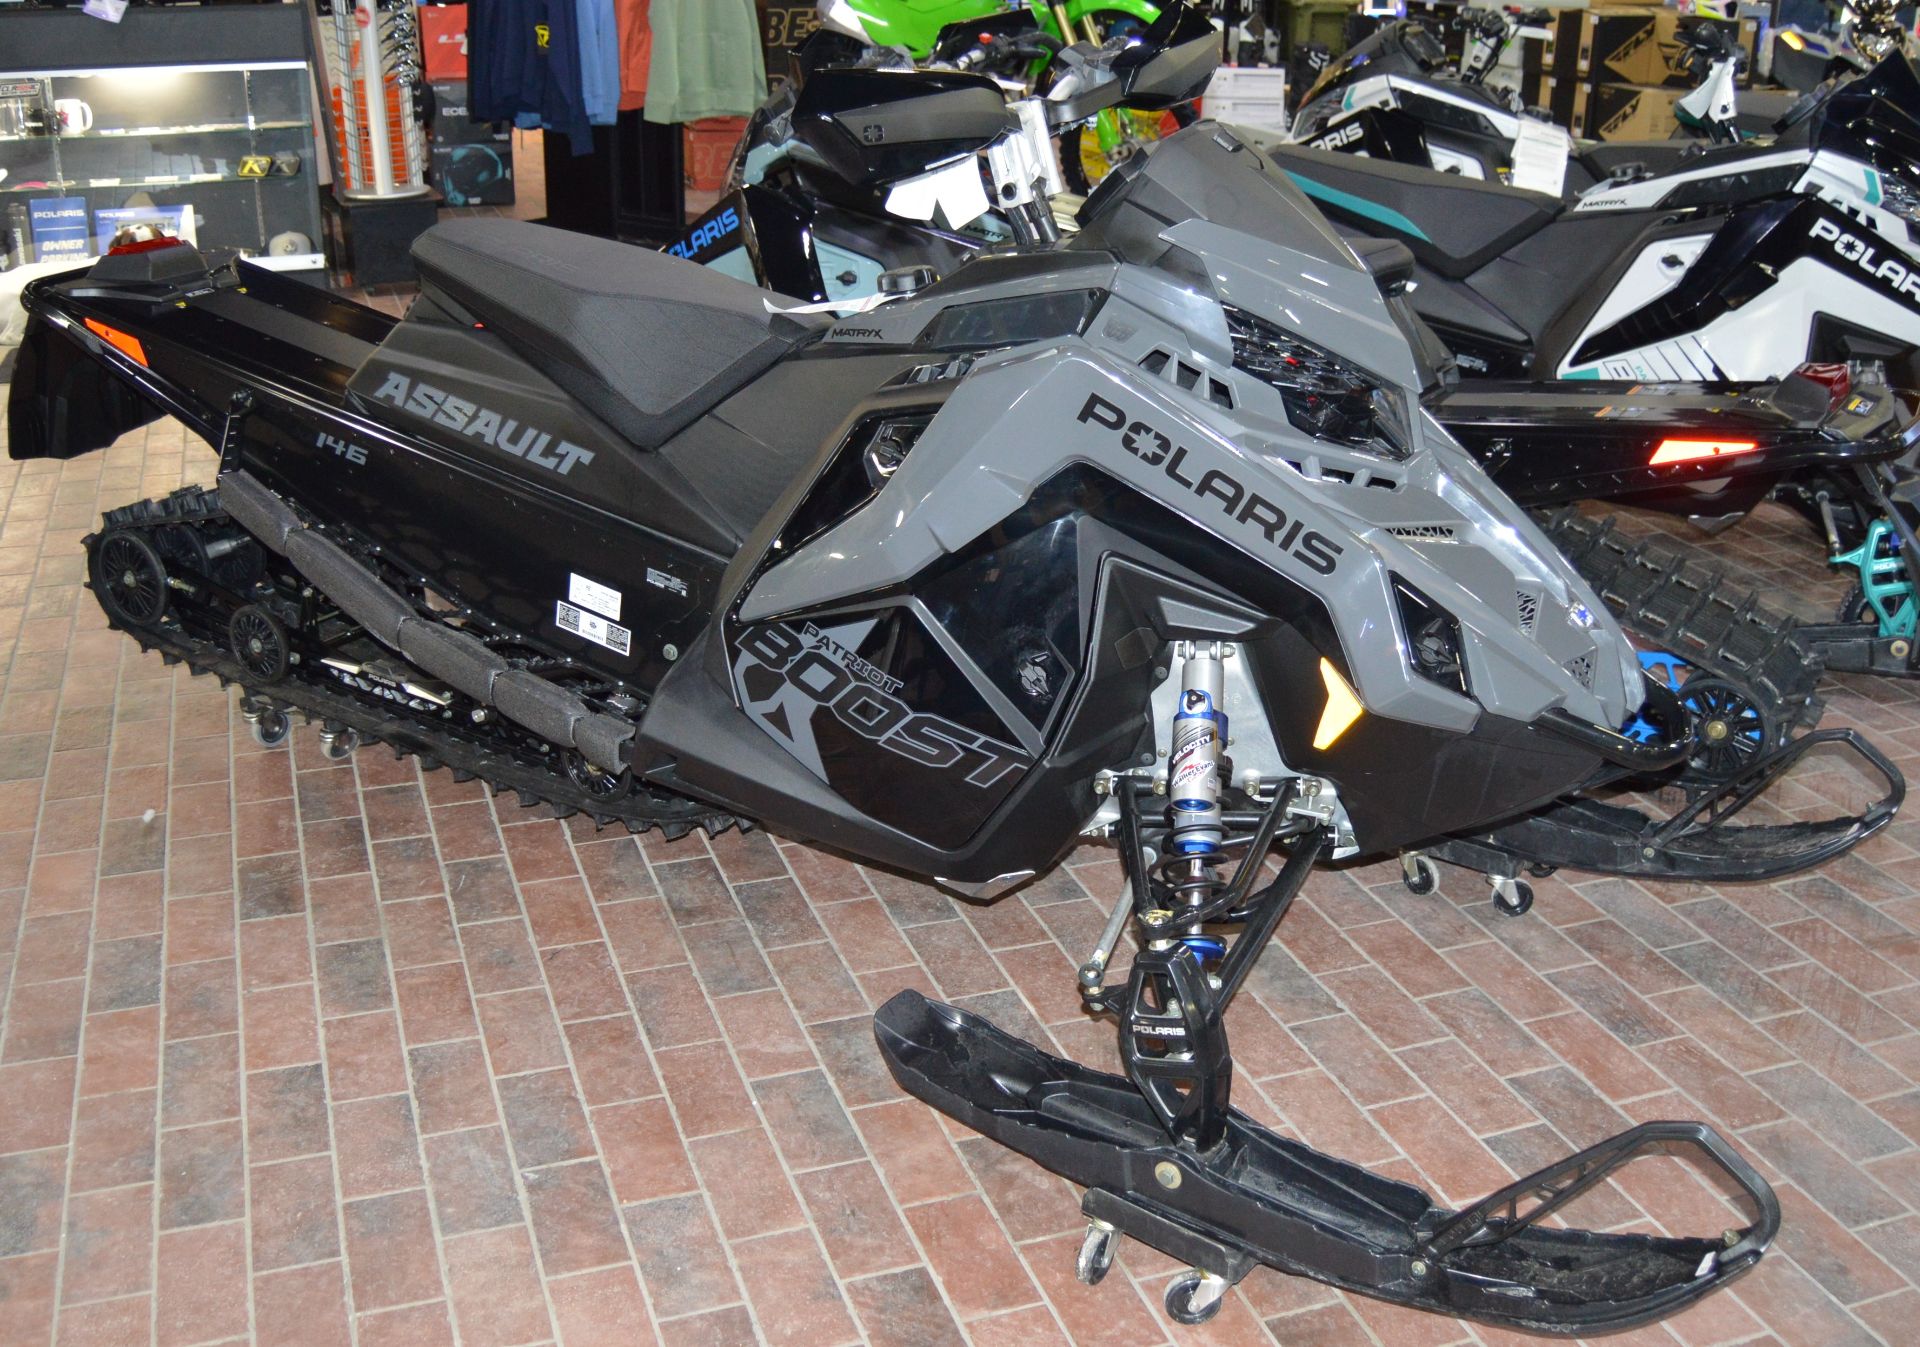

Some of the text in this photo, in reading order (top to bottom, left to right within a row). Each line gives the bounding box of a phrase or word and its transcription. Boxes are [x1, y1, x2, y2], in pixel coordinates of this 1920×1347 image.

[1310, 121, 1364, 152] ARIS
[33, 209, 86, 219] POLARIS
[42, 239, 85, 251] OWNER
[1808, 217, 1920, 304] POLAR
[831, 328, 884, 340] MATRYX
[373, 371, 595, 476] ASSAULT
[316, 432, 369, 466] 146
[1076, 392, 1344, 577] POLARIS
[803, 621, 904, 693] PATRIOT
[368, 673, 397, 687] POLARIS
[734, 622, 1034, 788] BOOST
[1173, 734, 1211, 764] VELOCITY
[1132, 1024, 1186, 1036] POLARIS
